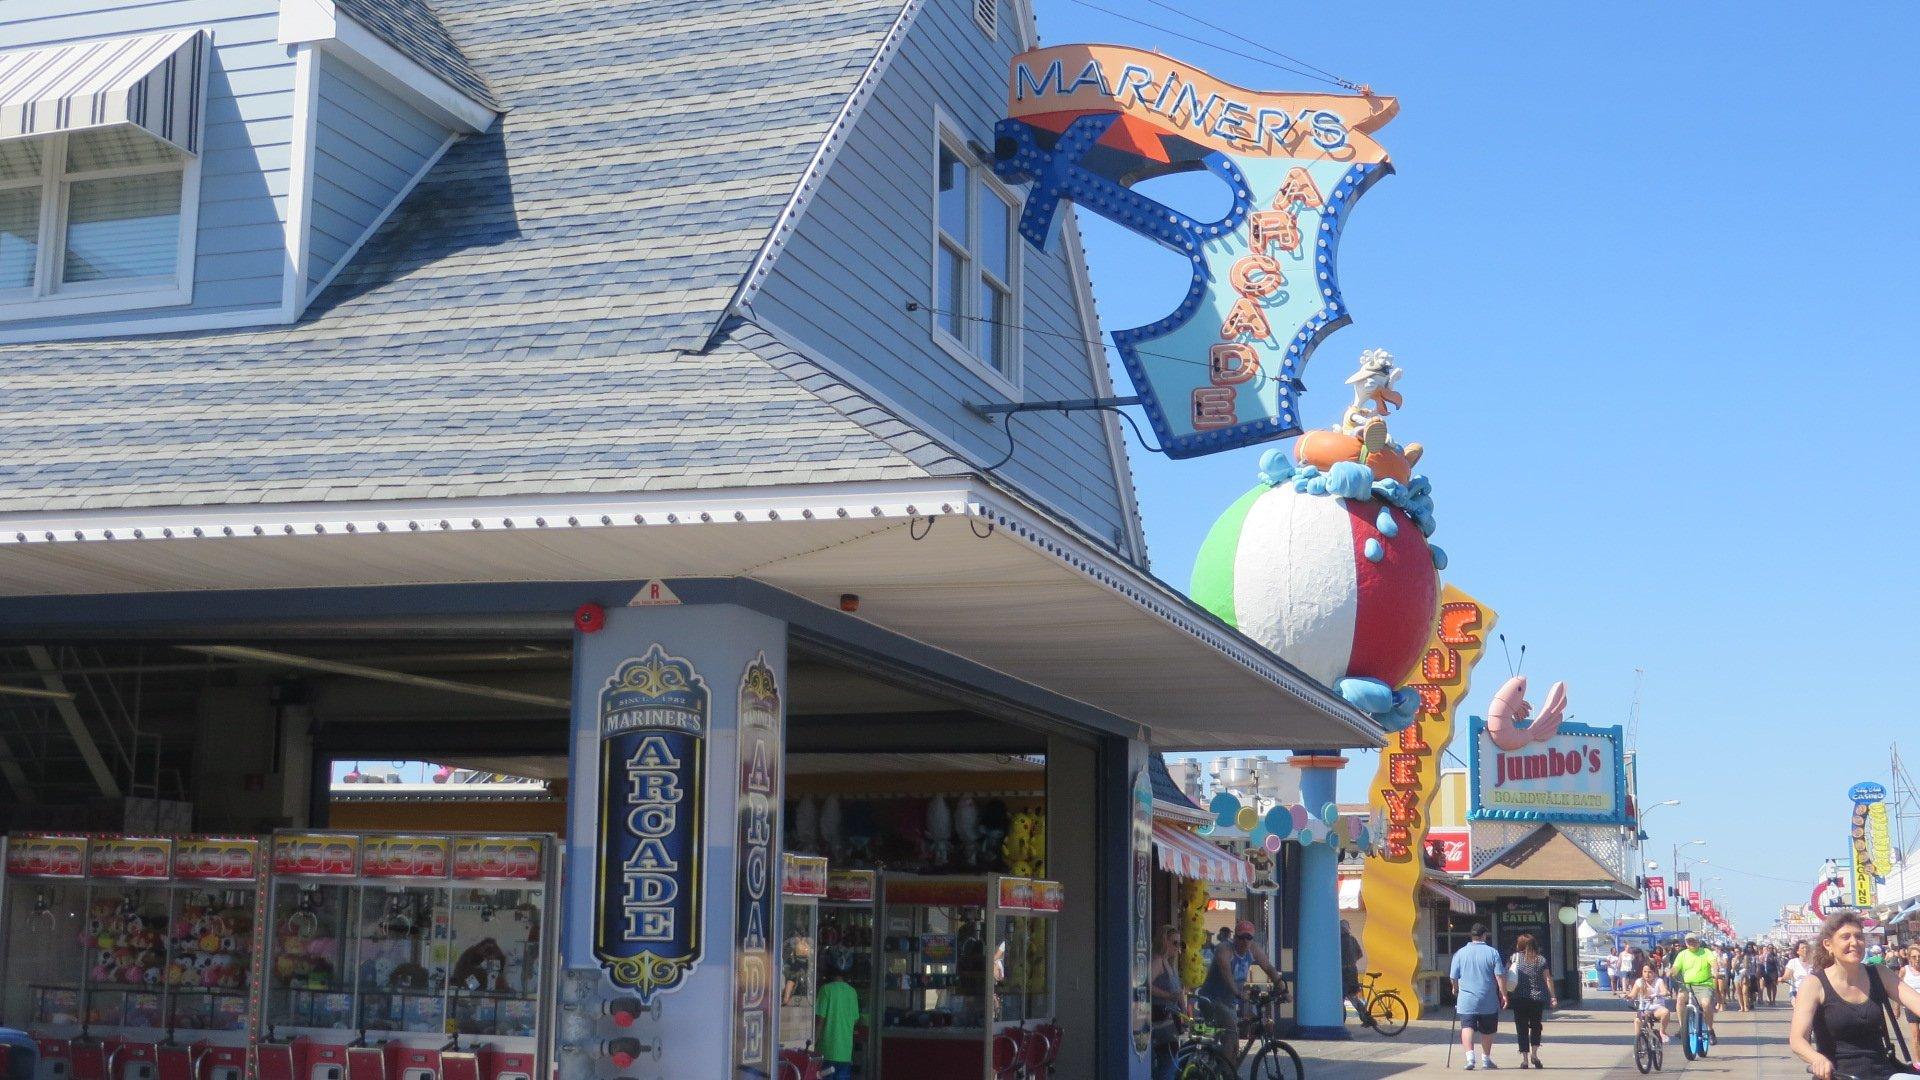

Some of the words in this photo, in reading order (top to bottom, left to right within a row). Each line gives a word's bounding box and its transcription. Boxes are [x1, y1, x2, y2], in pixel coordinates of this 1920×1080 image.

[1016, 60, 1347, 150] MARINER'S
[1191, 167, 1323, 430] ARCADE
[651, 583, 660, 599] R
[606, 709, 702, 732] MARINER'S
[1494, 790, 1570, 806] BOARDWALK
[1495, 745, 1601, 788] Jumbo's
[624, 736, 684, 941] ARCADE
[743, 740, 770, 1064] ARCADE
